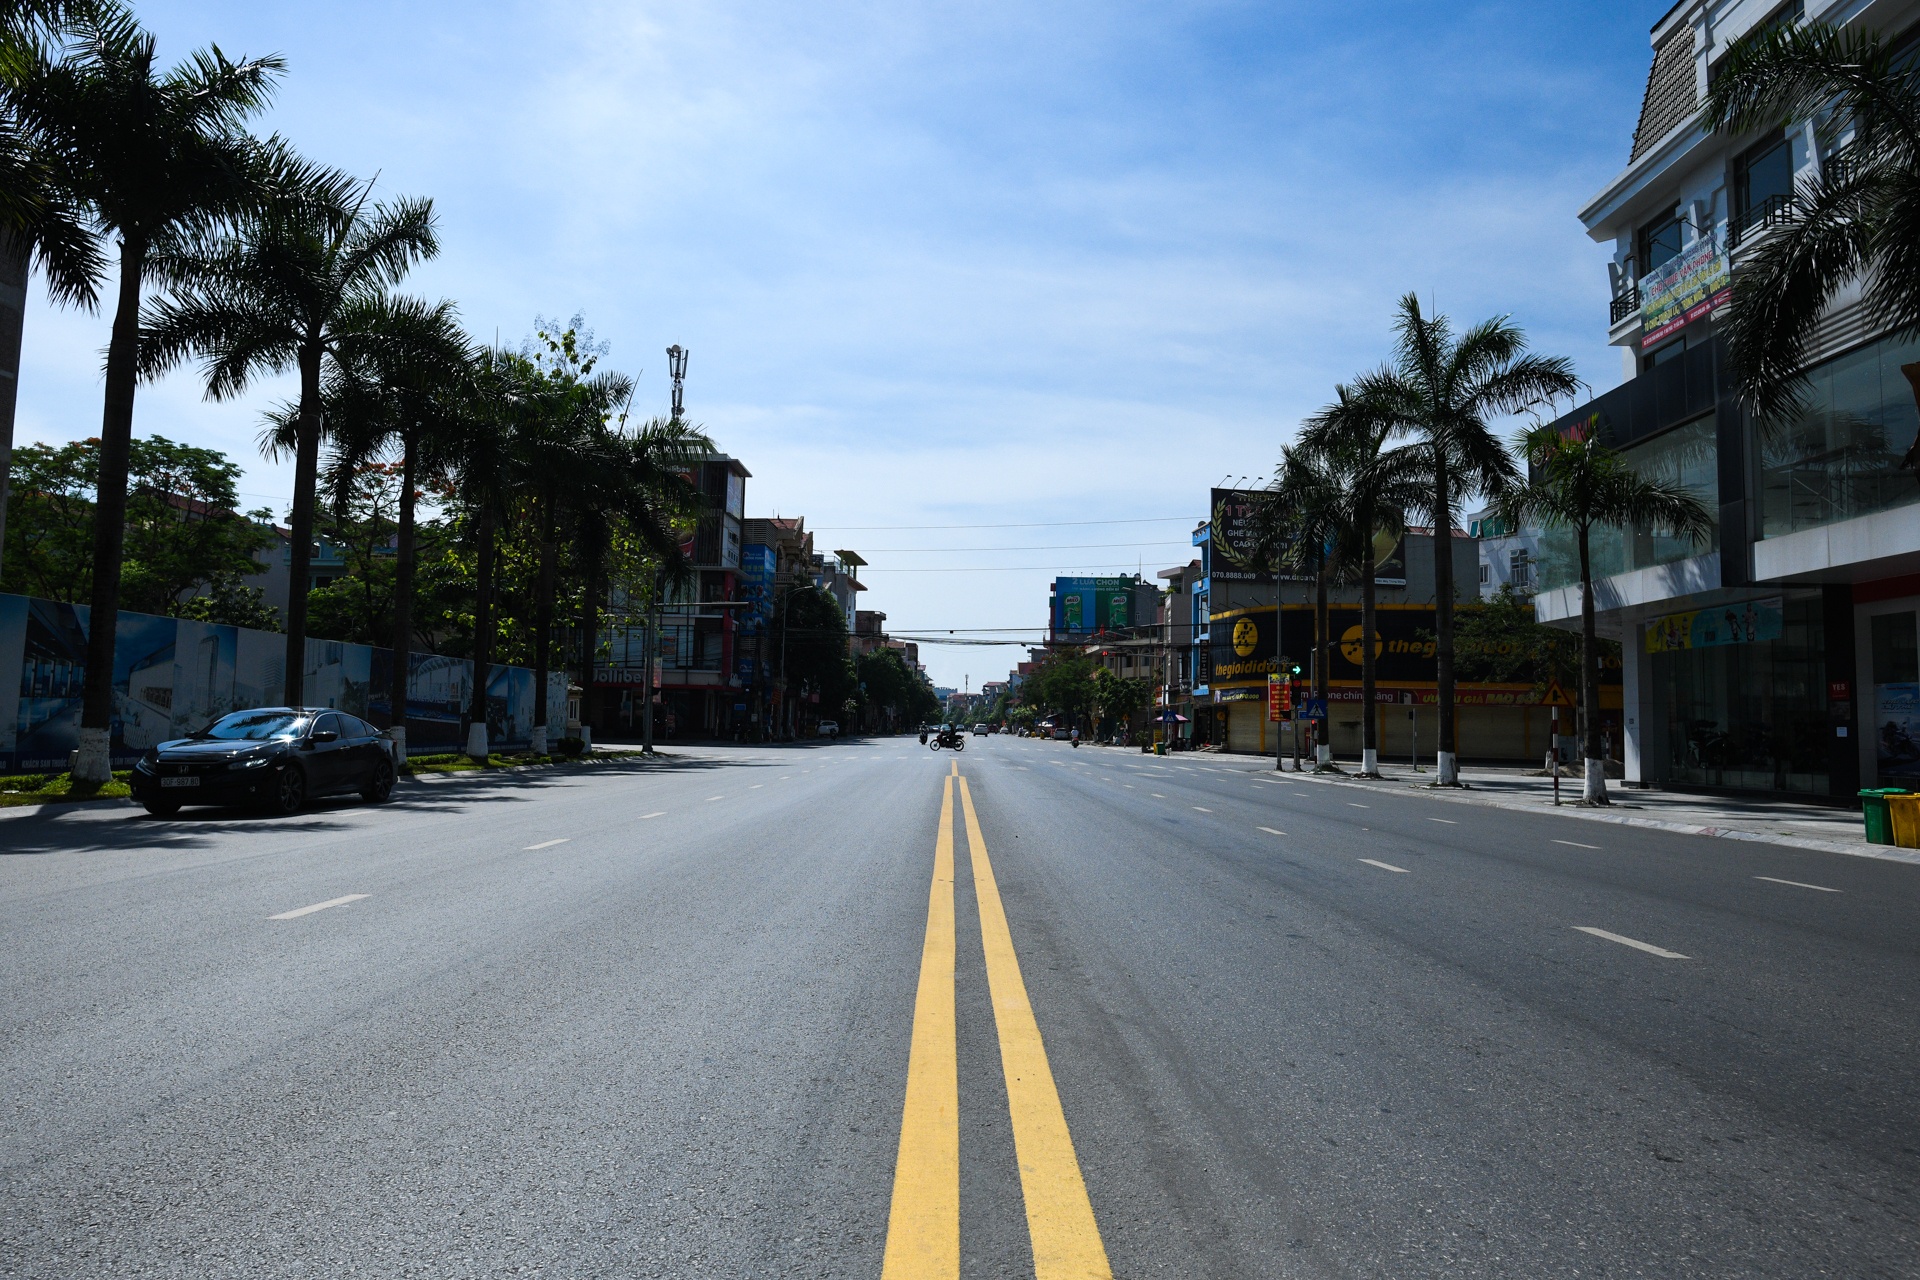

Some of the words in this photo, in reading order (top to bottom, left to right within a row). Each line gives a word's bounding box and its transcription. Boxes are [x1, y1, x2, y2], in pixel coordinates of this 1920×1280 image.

[1212, 571, 1257, 580] 070.8888.009
[593, 669, 644, 683] Jollibe
[1832, 683, 1846, 691] YES
[1343, 691, 1364, 700] chín
